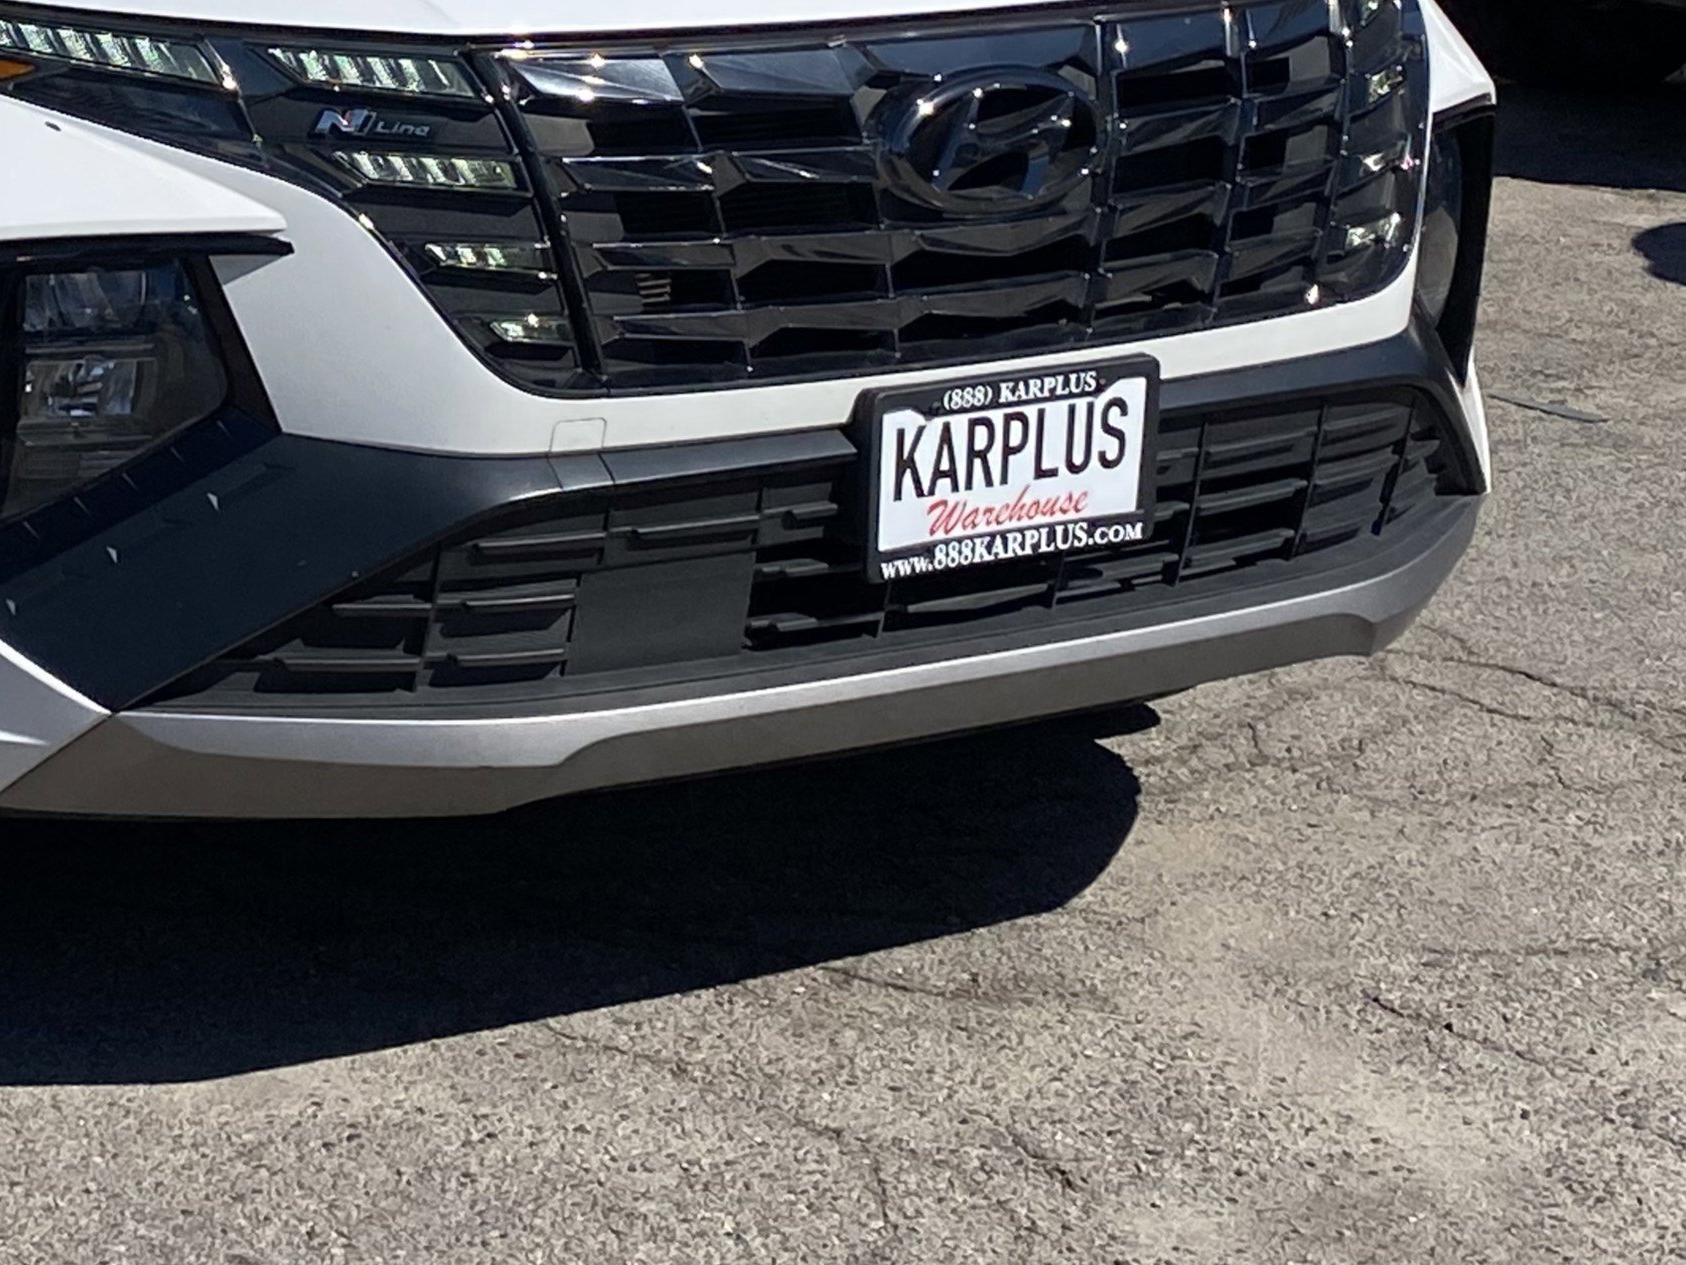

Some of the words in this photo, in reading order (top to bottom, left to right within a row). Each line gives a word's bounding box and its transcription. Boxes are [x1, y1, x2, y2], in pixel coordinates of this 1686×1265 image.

[375, 121, 431, 137] Line
[942, 385, 993, 411] (888)
[998, 370, 1097, 403] KARPLUS
[892, 396, 1129, 503] KARPLUS
[926, 485, 1089, 537] Warehouse
